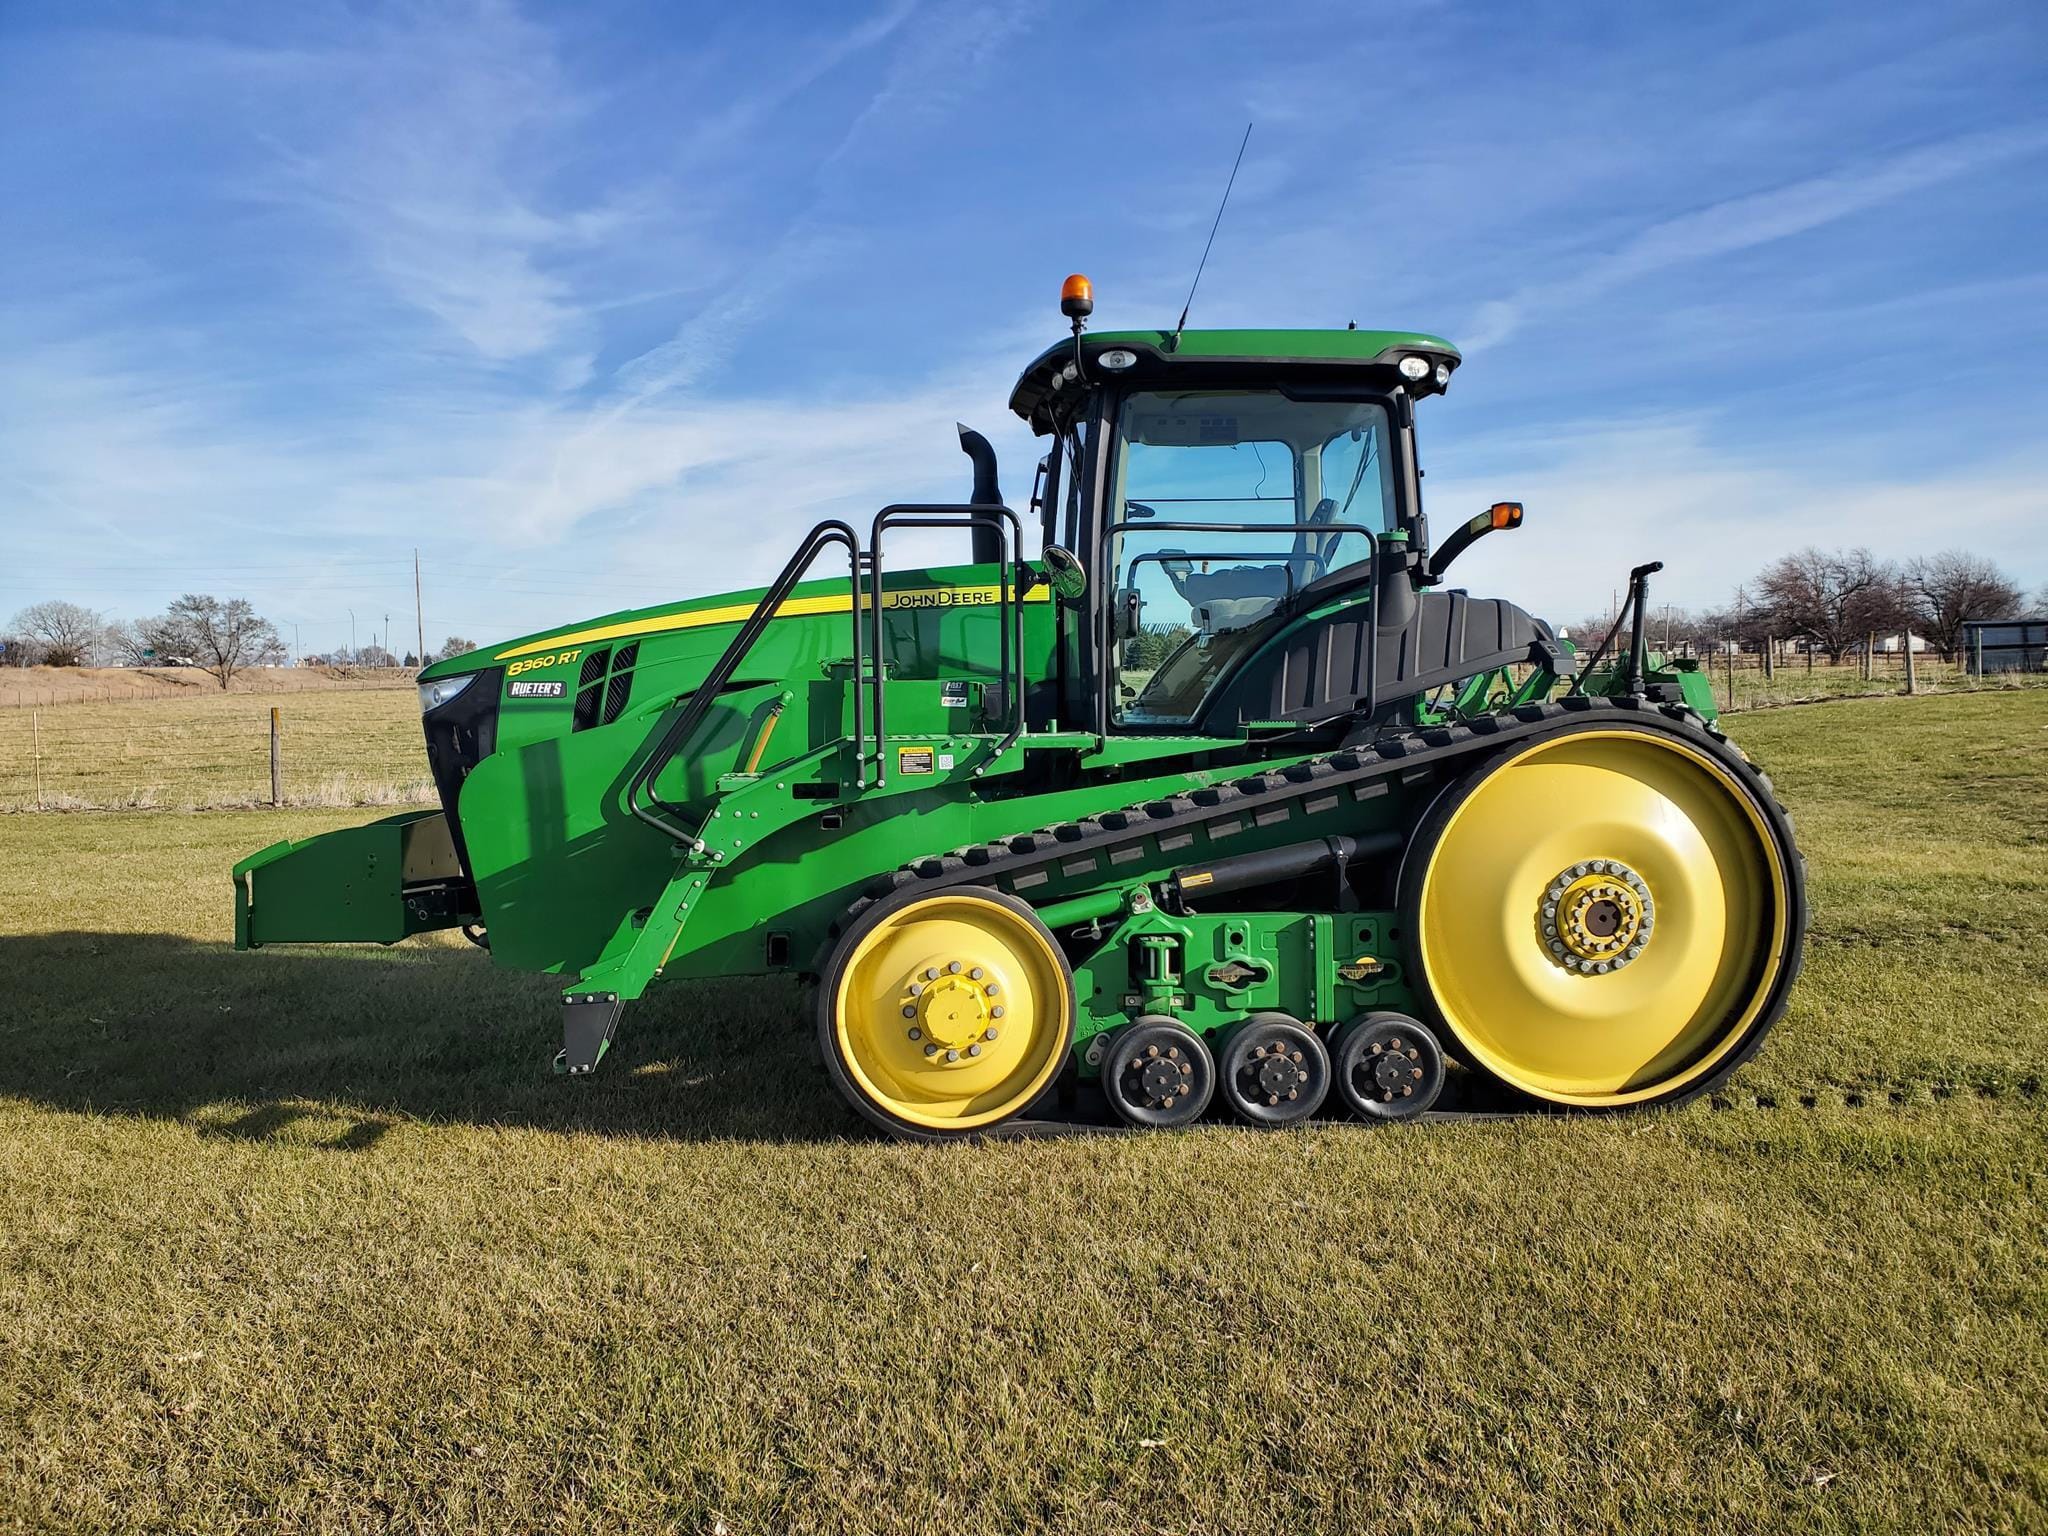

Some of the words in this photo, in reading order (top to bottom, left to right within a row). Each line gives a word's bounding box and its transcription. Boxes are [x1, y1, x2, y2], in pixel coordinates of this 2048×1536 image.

[890, 593, 936, 608] JOHN
[938, 591, 993, 605] DEERE
[507, 655, 556, 676] 8360
[558, 649, 582, 665] RT
[511, 682, 562, 695] RUETER'S
